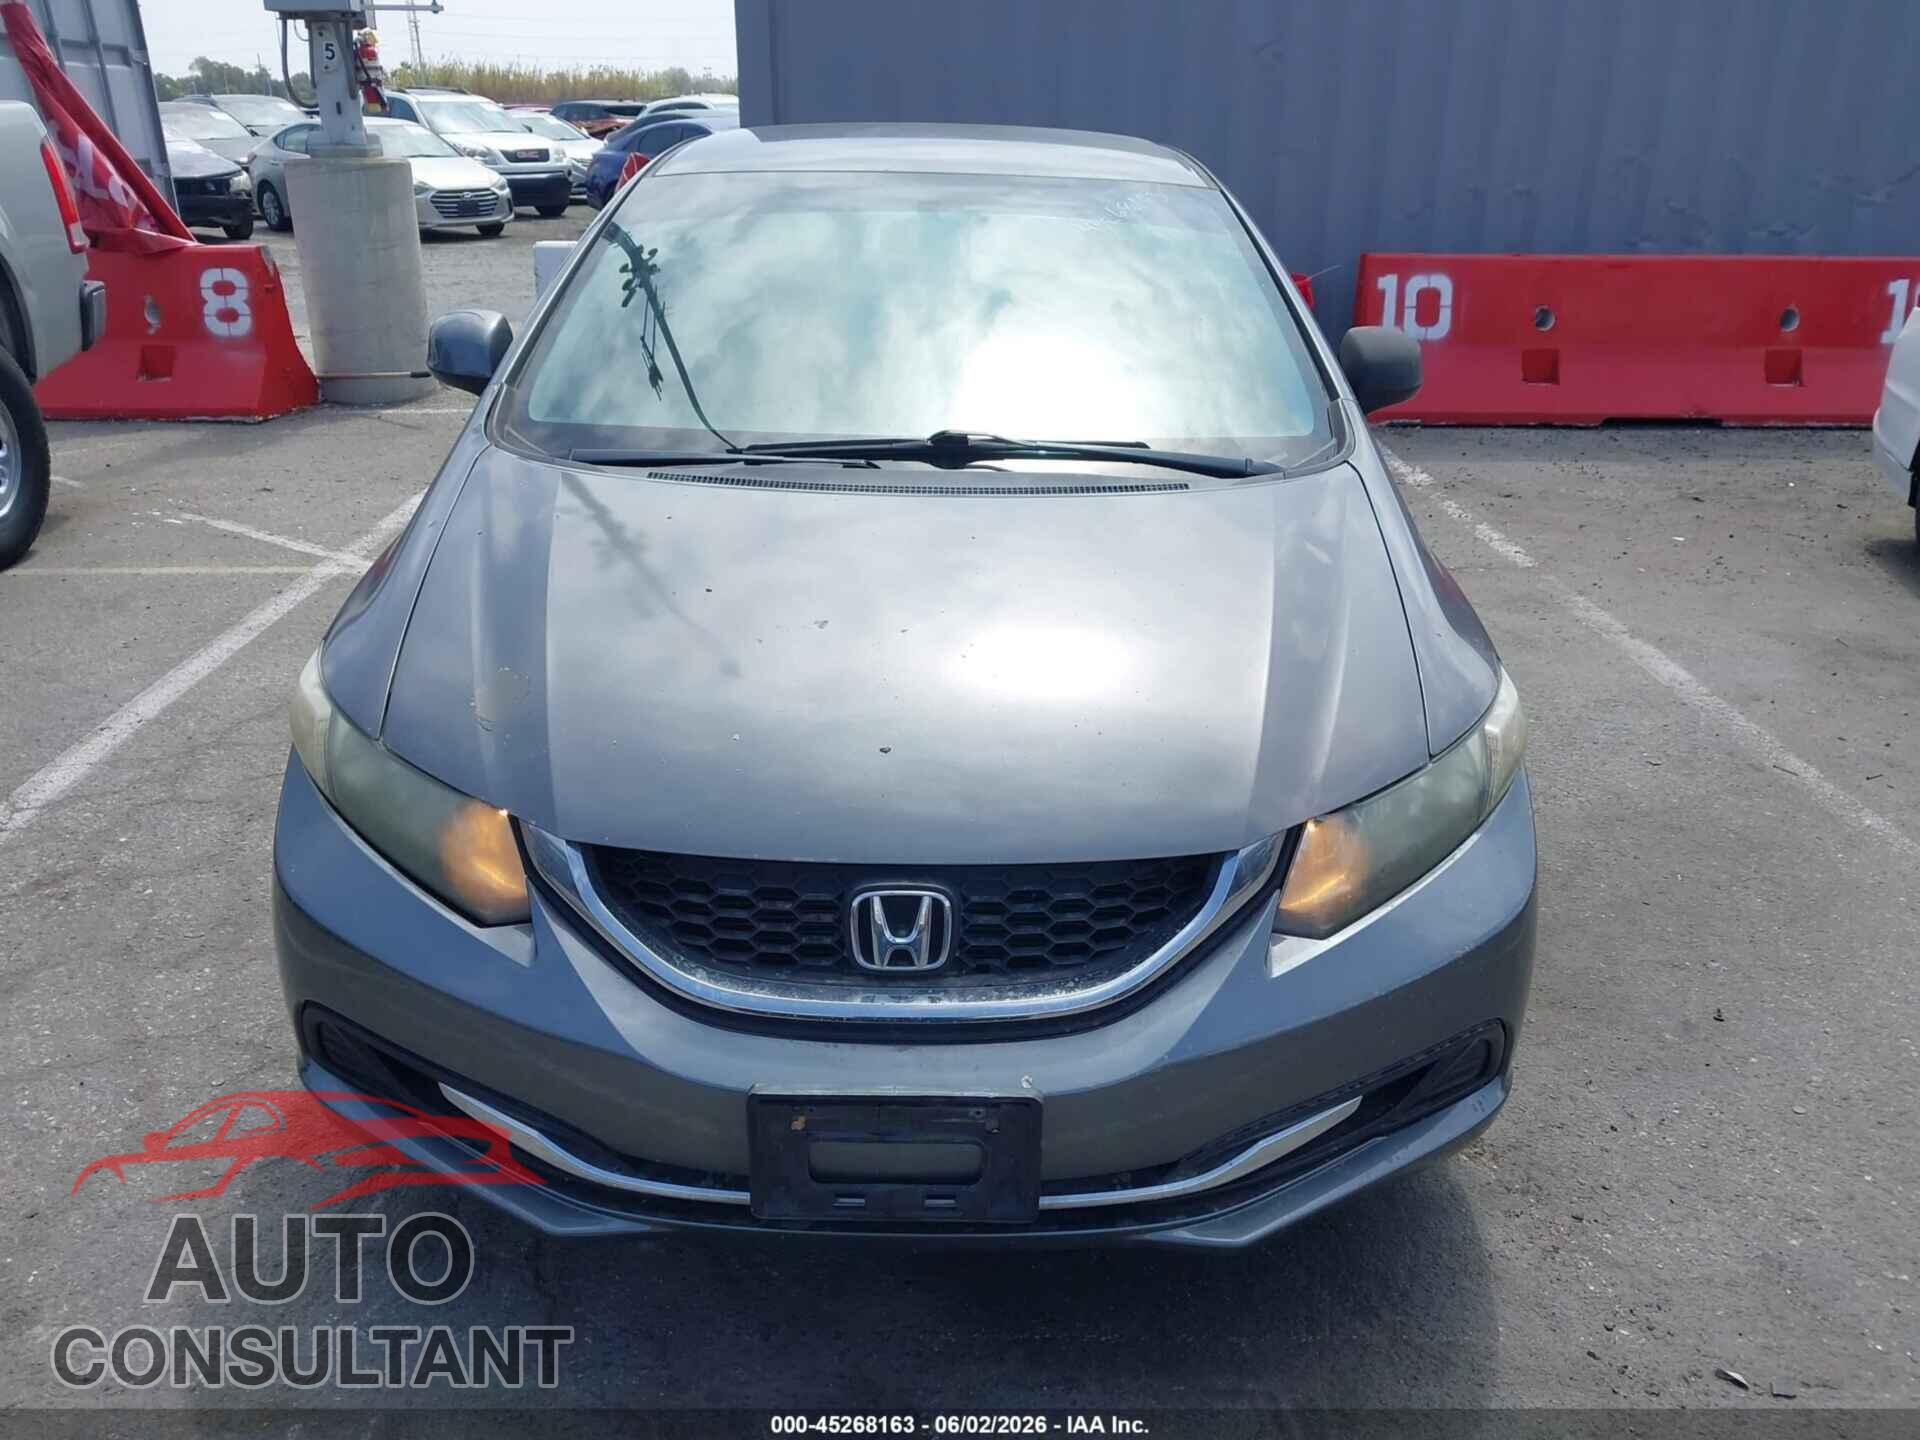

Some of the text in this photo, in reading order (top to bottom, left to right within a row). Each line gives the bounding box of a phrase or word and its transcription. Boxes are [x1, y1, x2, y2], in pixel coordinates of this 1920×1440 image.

[324, 42, 336, 60] 5
[200, 267, 252, 336] 8
[1376, 272, 1453, 340] 10
[1880, 278, 1920, 344] 1
